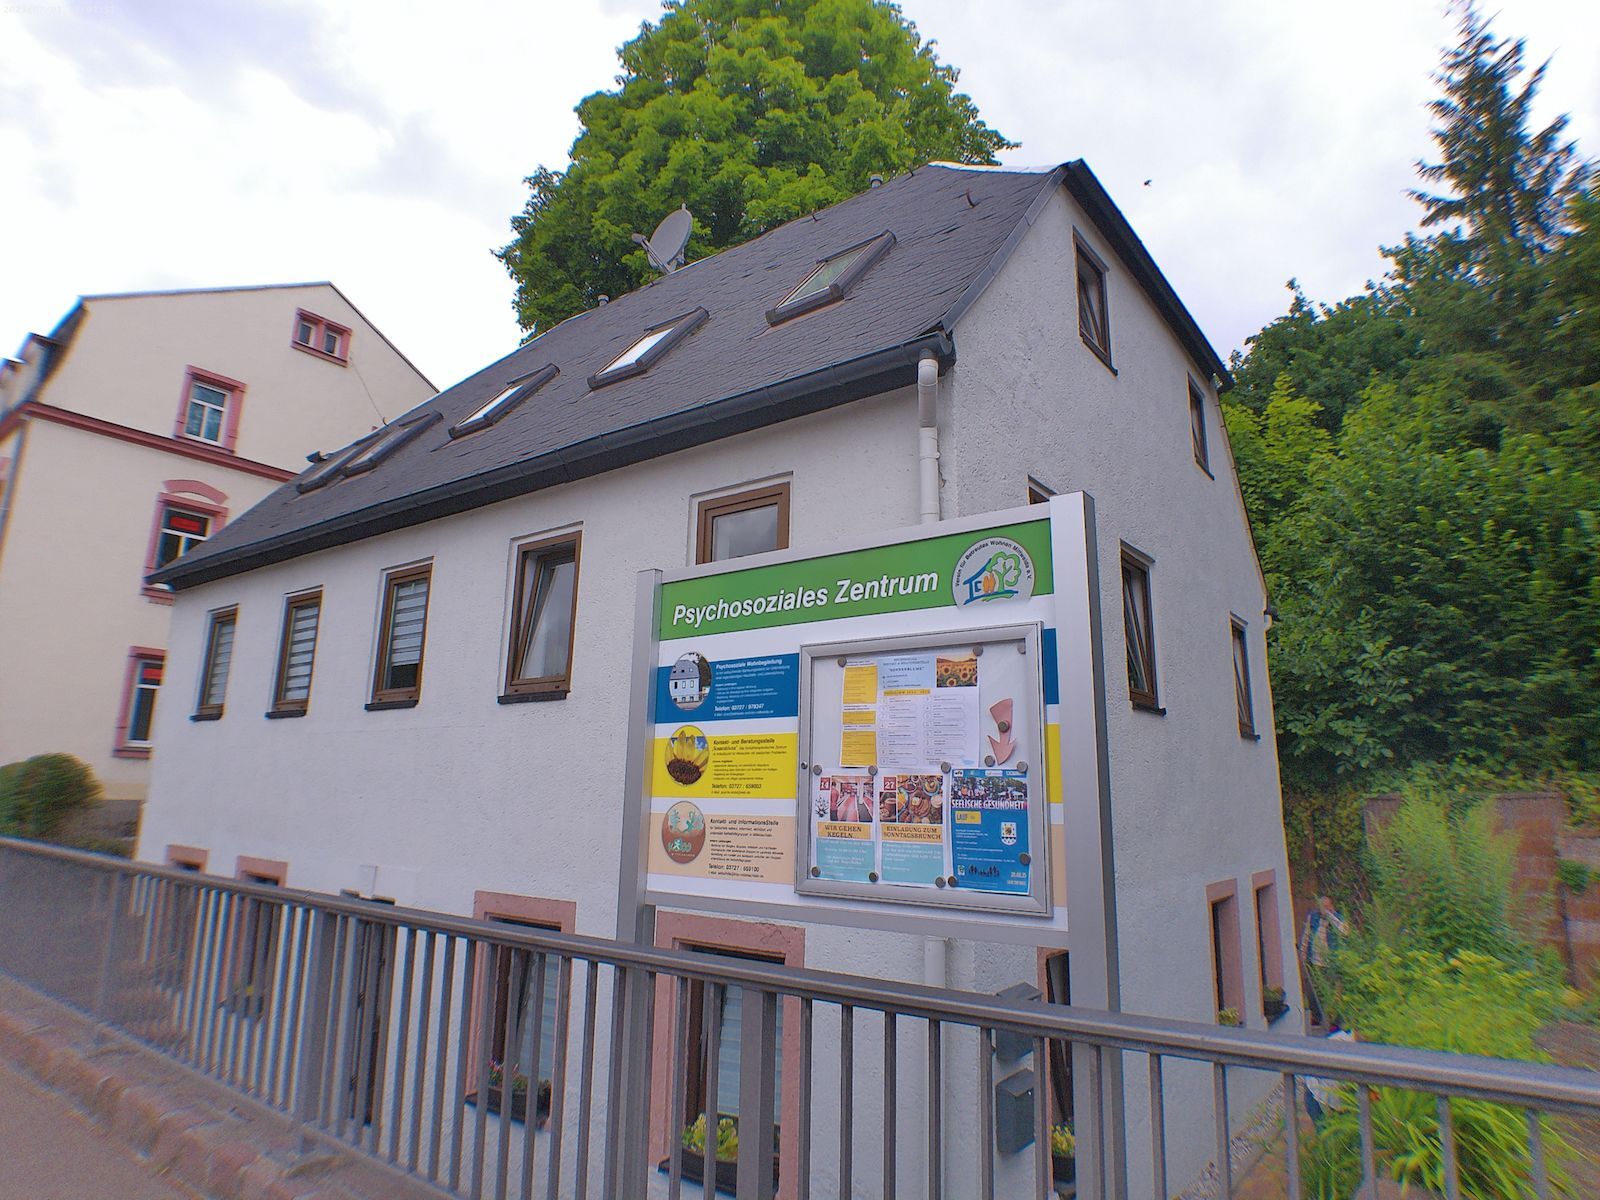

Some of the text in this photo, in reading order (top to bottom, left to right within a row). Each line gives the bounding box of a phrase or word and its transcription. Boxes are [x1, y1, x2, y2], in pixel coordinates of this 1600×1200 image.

[959, 560, 967, 569] für
[965, 543, 989, 560] Betreutes
[990, 540, 1012, 548] Wohnen
[673, 570, 940, 628] Psychosoziales Zentrum
[884, 781, 895, 789] 27
[951, 798, 1024, 810] SEELISCHE GESUNDHEIT
[883, 832, 942, 840] SONNTAGSBRUNCH
